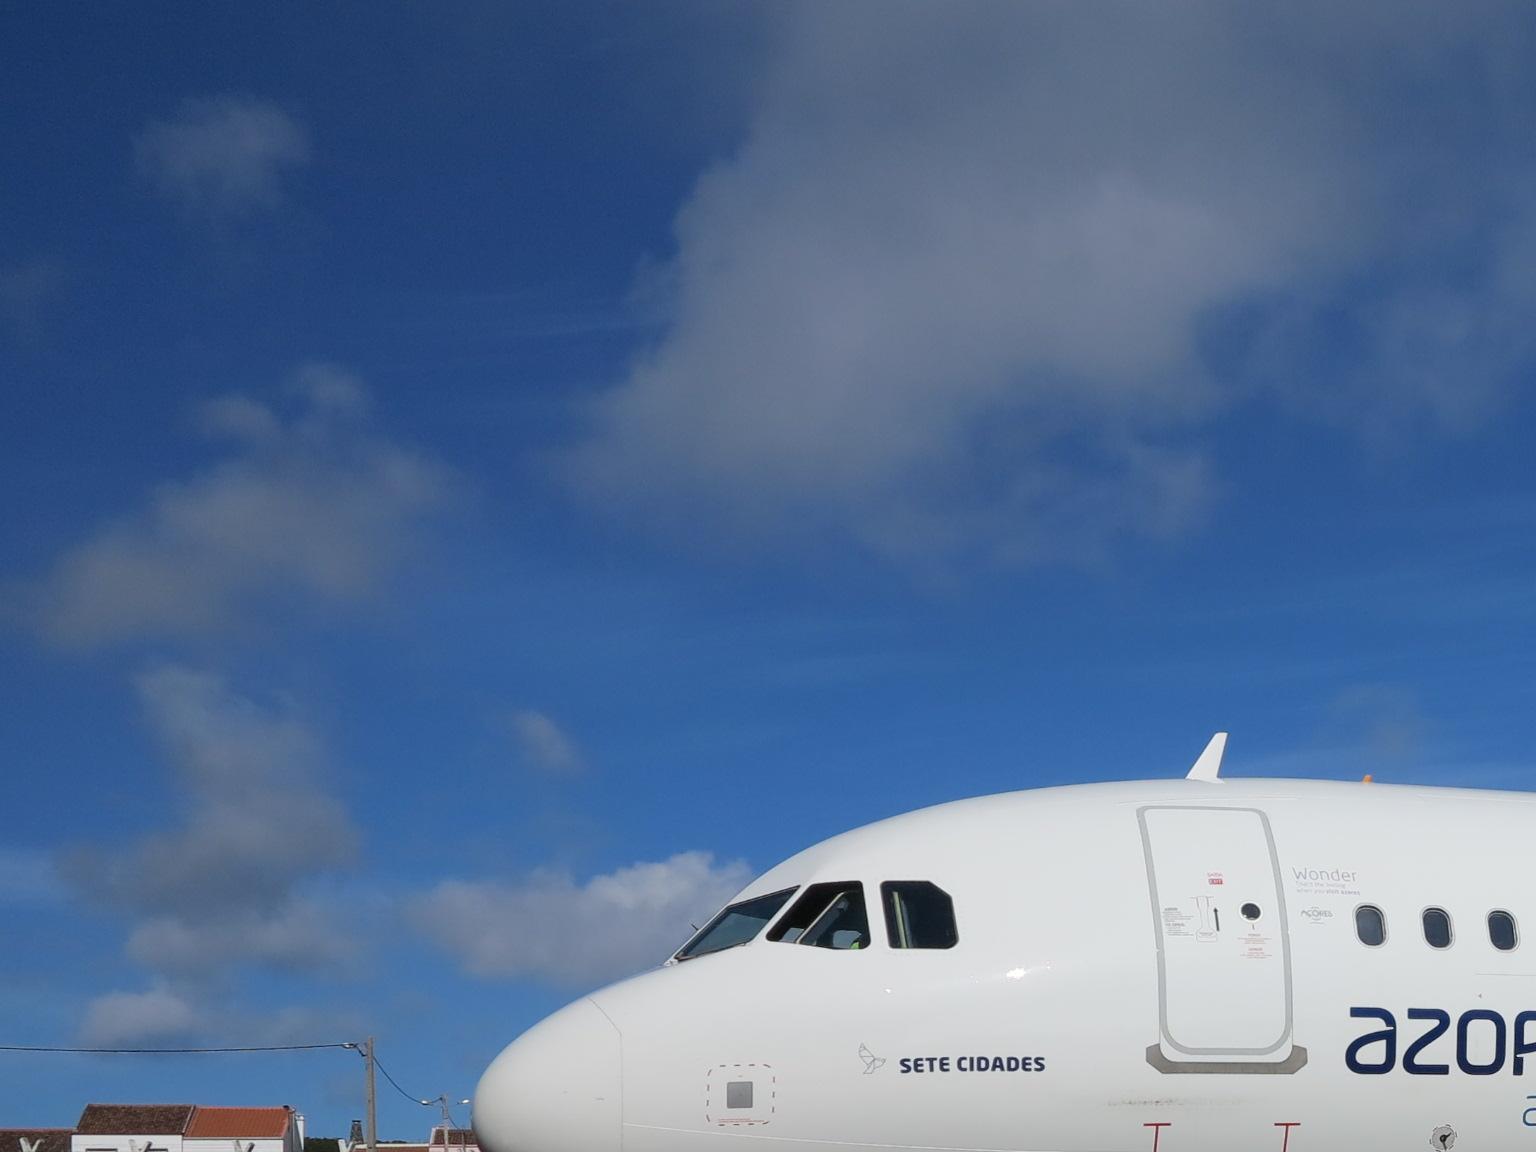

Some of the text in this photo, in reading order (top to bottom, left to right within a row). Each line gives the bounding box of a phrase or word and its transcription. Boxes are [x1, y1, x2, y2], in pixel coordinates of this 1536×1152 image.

[1292, 867, 1358, 882] Wonder
[899, 1056, 1046, 1074] SETE CIDADES
